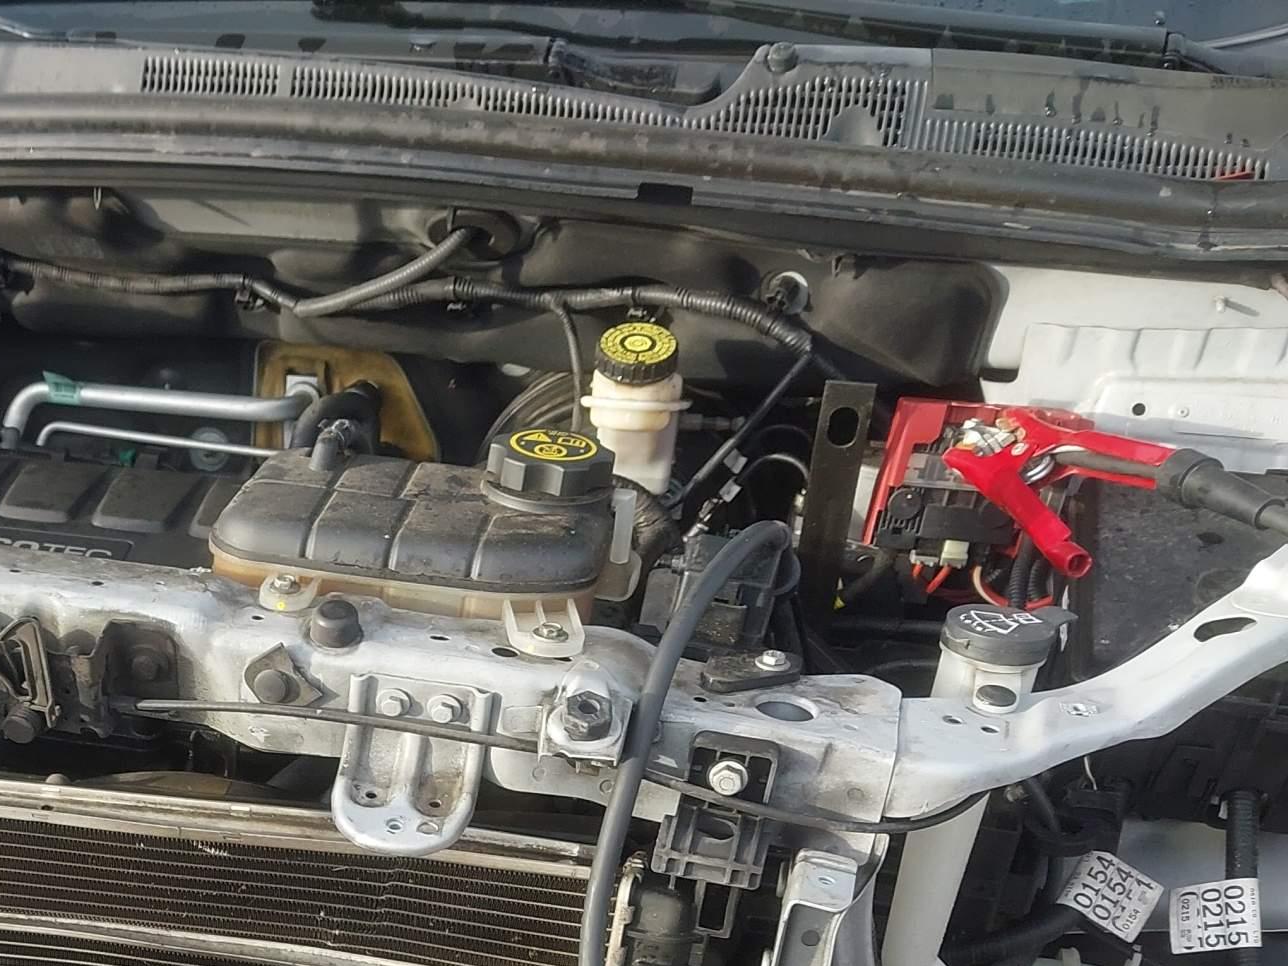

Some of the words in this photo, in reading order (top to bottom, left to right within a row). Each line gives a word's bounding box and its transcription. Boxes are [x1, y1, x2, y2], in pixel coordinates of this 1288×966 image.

[1073, 855, 1116, 909] 0154
[1092, 866, 1134, 921] 0154
[1121, 908, 1142, 931] 0154
[1180, 898, 1191, 922] 0215
[1200, 888, 1227, 948] 0215
[1223, 885, 1249, 946] 0215
